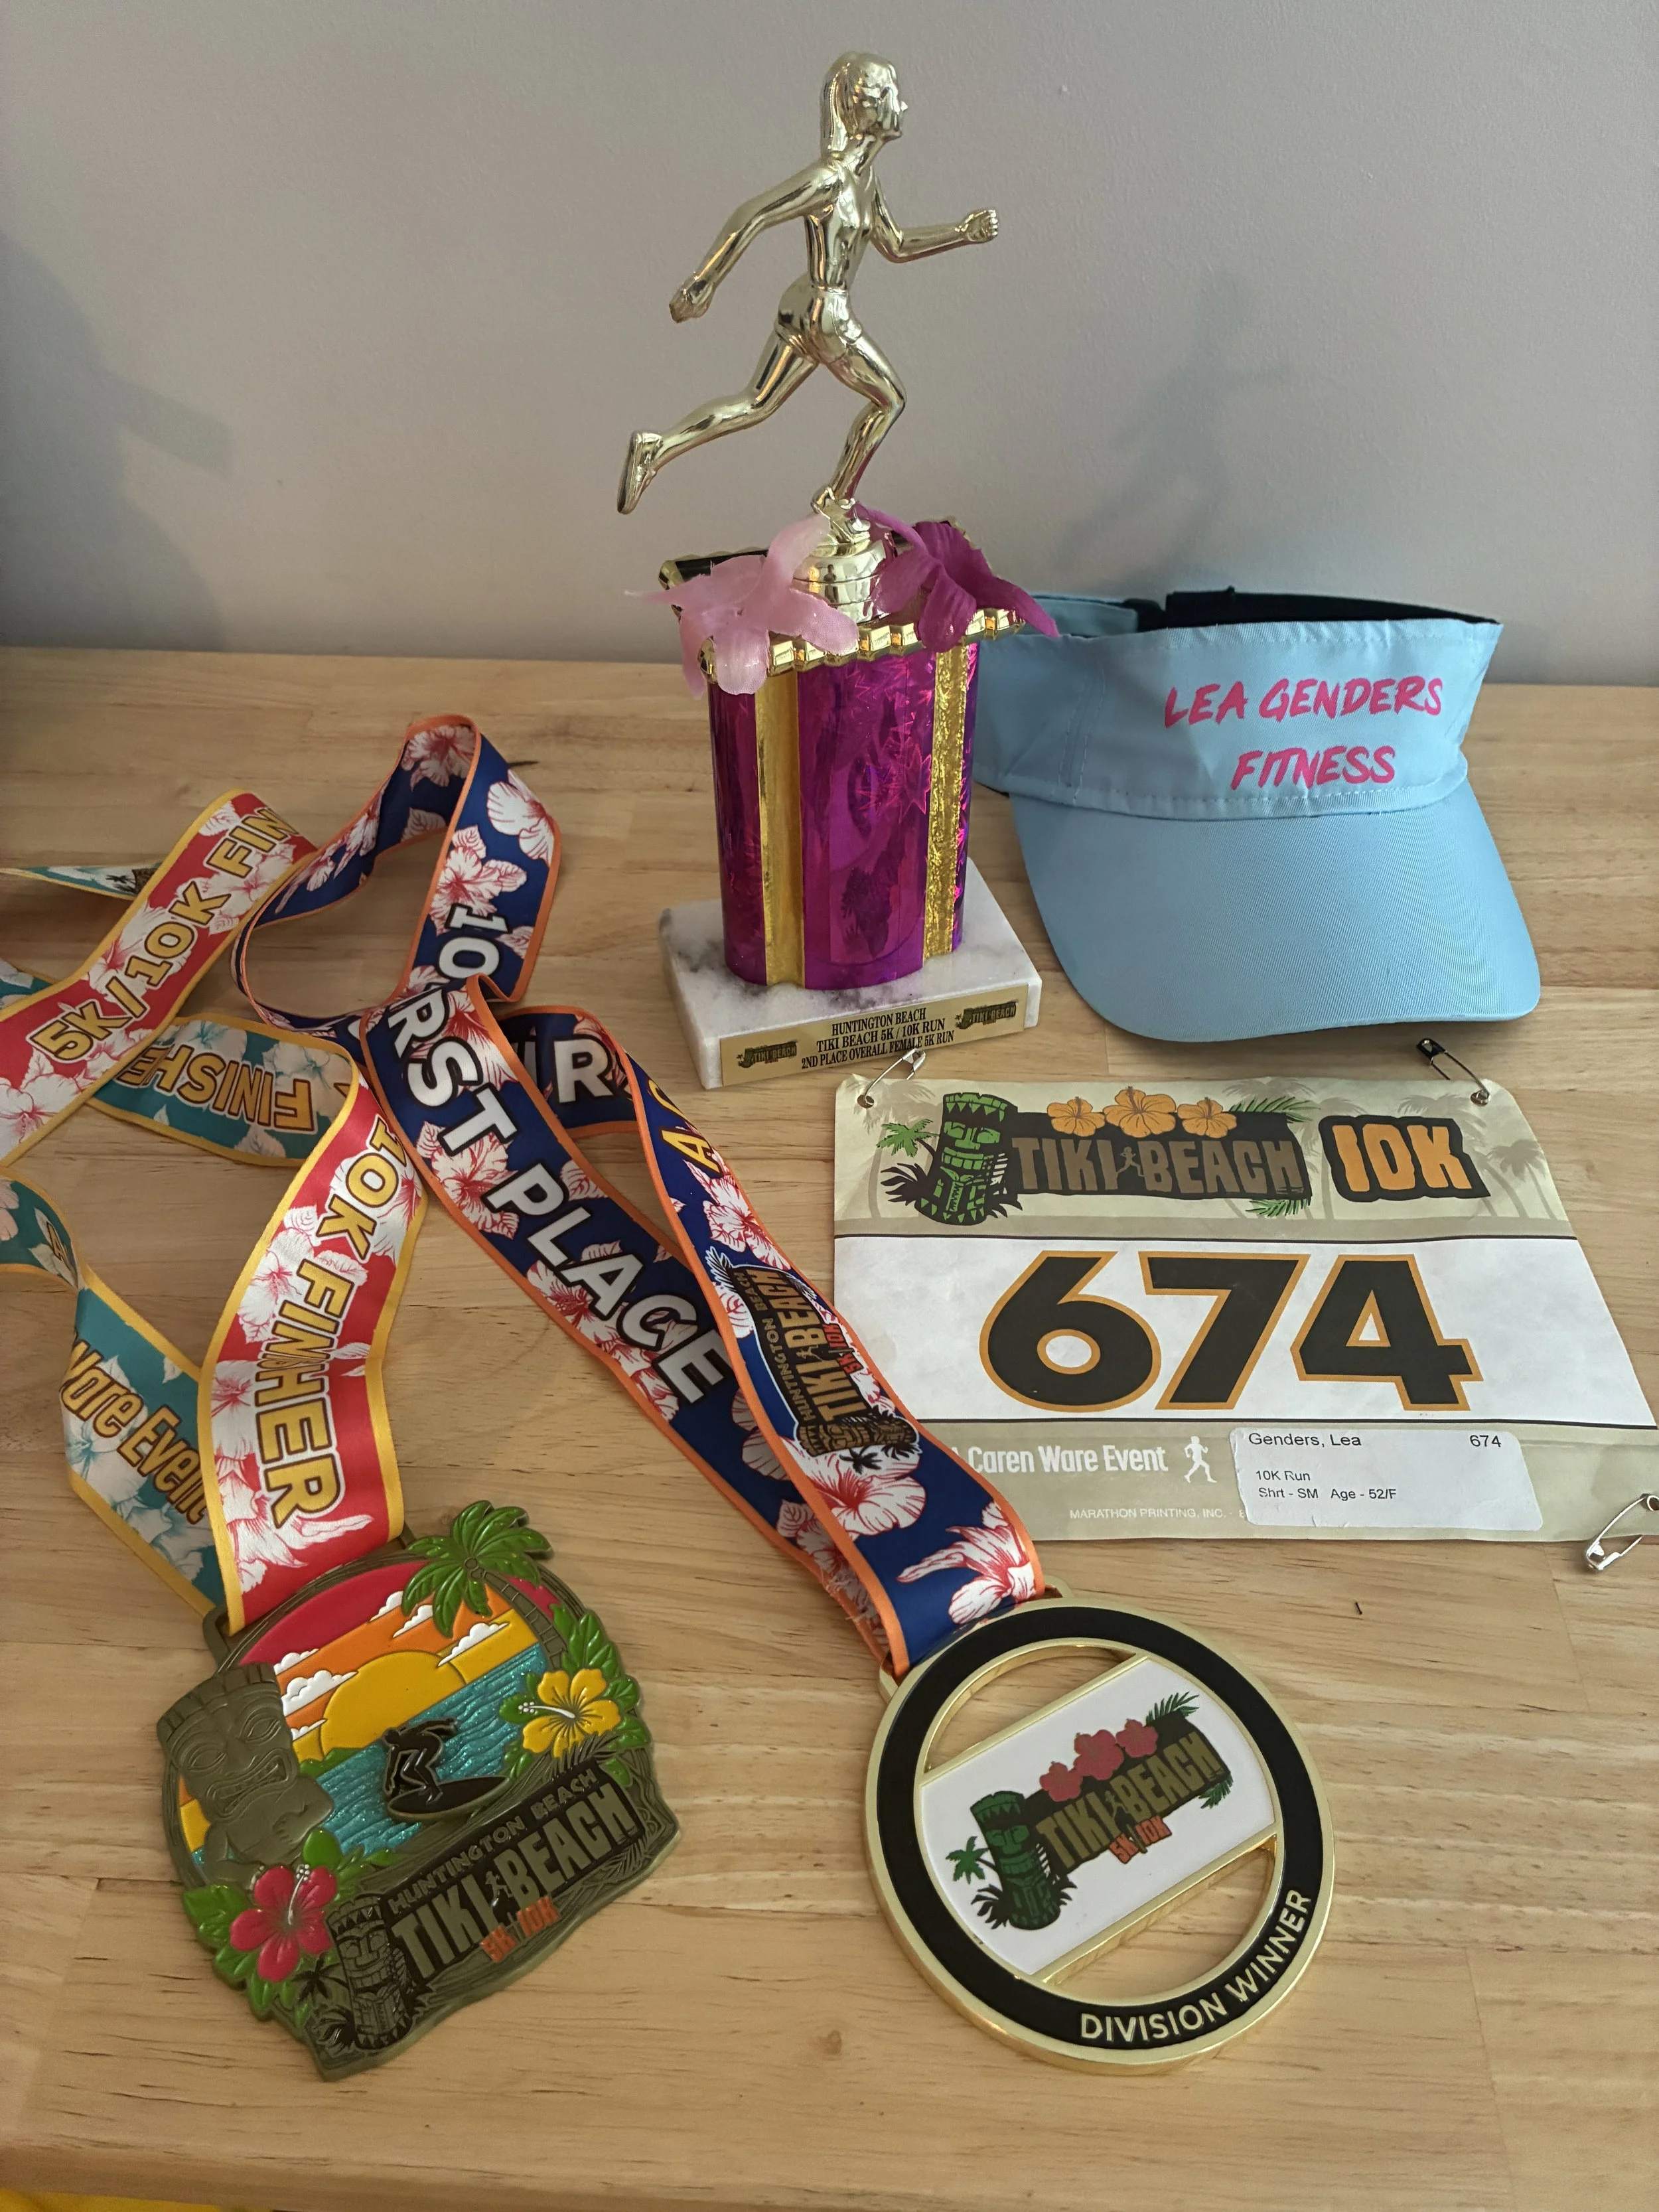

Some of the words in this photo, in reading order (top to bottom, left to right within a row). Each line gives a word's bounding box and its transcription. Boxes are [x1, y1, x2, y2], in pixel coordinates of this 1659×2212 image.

[1164, 680, 1248, 728] LEA
[1259, 675, 1443, 723] GENDERS
[1230, 745, 1396, 790] FITNESS
[31, 881, 232, 1063] 5K/10K
[435, 903, 512, 981] 10
[802, 1056, 818, 1069] 2ND
[820, 1051, 847, 1066] PLACE
[849, 1043, 887, 1060] OVERALL
[889, 1035, 922, 1053] FEMALE
[924, 1035, 934, 1047] 5K
[936, 1030, 955, 1044] RUN
[817, 1037, 839, 1053] TIKI
[843, 1031, 878, 1048] BEACH
[881, 1028, 894, 1041] 5K
[902, 1023, 919, 1037] 10K
[922, 1018, 946, 1032] RUN
[831, 1013, 893, 1036] HUNTINGTON
[895, 1007, 926, 1025] BEACH
[319, 1116, 407, 1260] 10K
[1012, 1137, 1119, 1192] TIKI
[1137, 1139, 1305, 1194] BEACH
[1332, 1124, 1473, 1193] 10K
[385, 988, 520, 1155] RST
[484, 1163, 733, 1405] PLACE
[736, 1272, 766, 1311] BEACH
[747, 1269, 828, 1349] BEACH
[979, 1250, 1483, 1412] 674
[254, 1259, 356, 1529] FINHER
[762, 1318, 816, 1422] HUNTINGTON
[796, 1359, 867, 1422] TIKI
[968, 1446, 1035, 1473] Caren
[1038, 1445, 1098, 1472] Ware
[1103, 1445, 1168, 1471] Event
[1249, 1433, 1325, 1448] Genders,
[1331, 1434, 1361, 1447] Lea
[1470, 1435, 1502, 1447] 674
[1256, 1471, 1281, 1481] 10K
[1285, 1471, 1311, 1481] Run
[1297, 1489, 1319, 1499] SM
[1331, 1489, 1356, 1501] Age
[1368, 1489, 1397, 1500] 52/F
[1070, 1509, 1137, 1519] MARATHON
[1140, 1508, 1199, 1520] PRINTING,
[1202, 1508, 1226, 1518] INC.
[1035, 1789, 1121, 1869] TIKI
[1110, 1732, 1222, 1820] BEACH
[388, 1815, 528, 1915] HUNTINGTON
[530, 1769, 598, 1820] BEACH
[392, 1876, 500, 1979] TIKI
[494, 1784, 637, 1909] BEACH
[1080, 1992, 1228, 2043] DIVISION
[1226, 1889, 1313, 2004] WINNER
